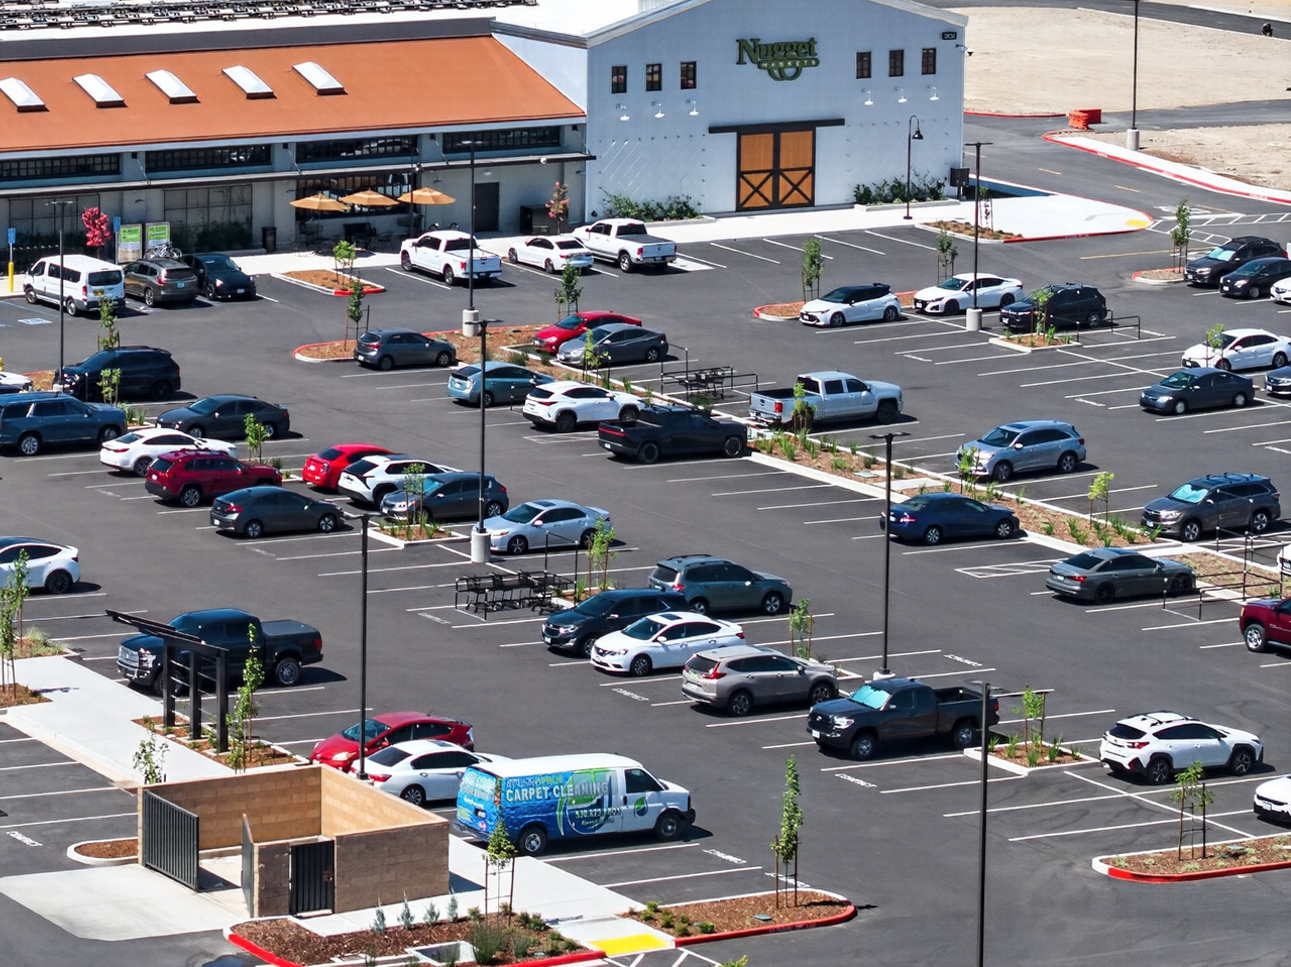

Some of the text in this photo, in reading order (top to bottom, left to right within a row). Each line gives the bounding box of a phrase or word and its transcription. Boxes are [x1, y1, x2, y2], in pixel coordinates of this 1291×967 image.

[736, 37, 817, 65] Nugget
[506, 786, 551, 802] CARPET
[553, 781, 609, 797] CLEANING
